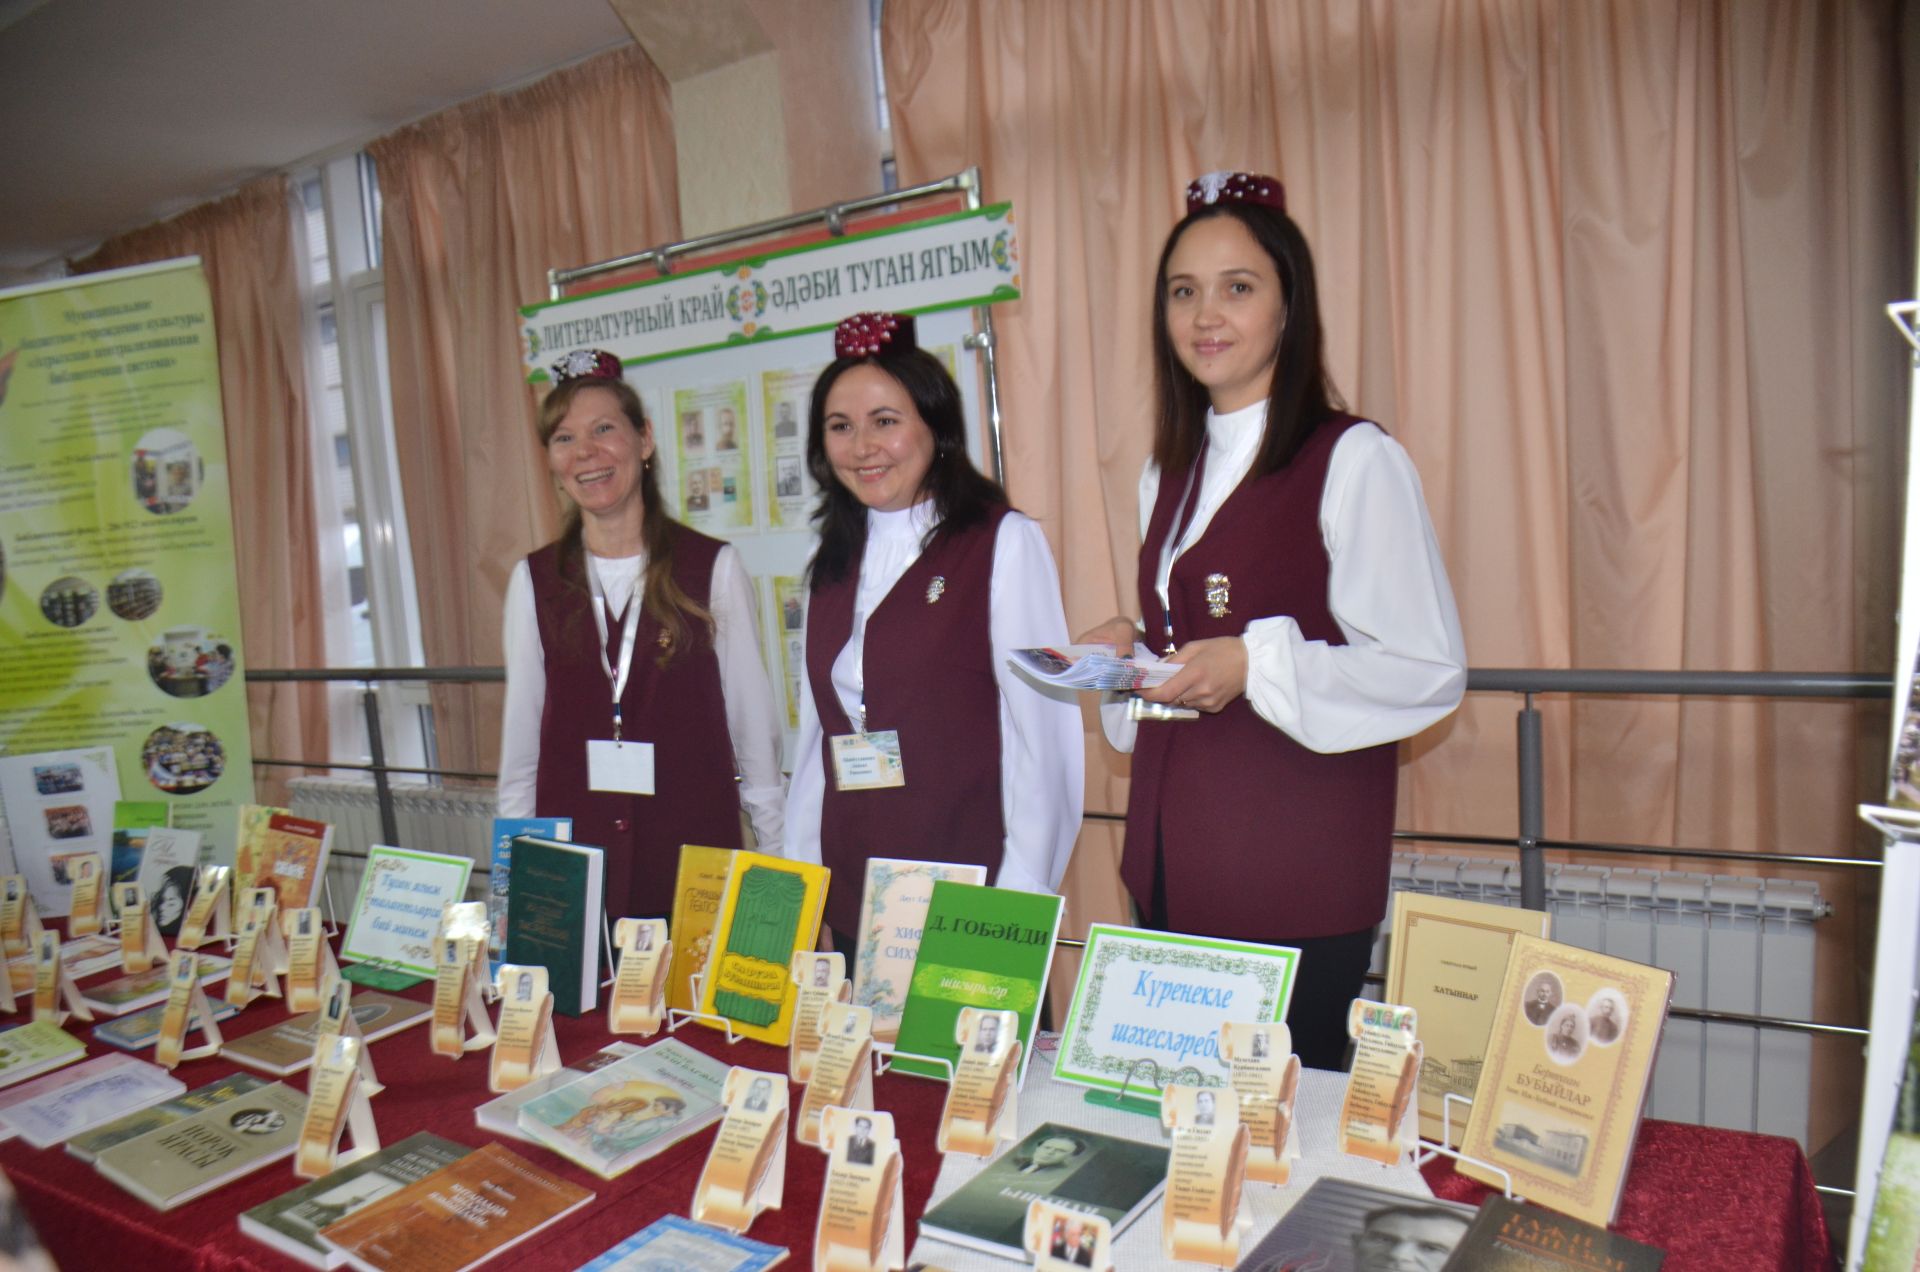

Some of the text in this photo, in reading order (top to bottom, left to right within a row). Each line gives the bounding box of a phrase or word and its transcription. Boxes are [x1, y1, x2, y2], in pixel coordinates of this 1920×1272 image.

[771, 237, 991, 312] ӘДӘБИ ТУГАН ЯГЫМ
[542, 285, 726, 350] ЛИТЕРАТУРНЫЙ КРАЙ
[929, 914, 1049, 946] Д. ГОБӘЙДИ
[1132, 969, 1234, 1009] Күренекле
[1433, 985, 1479, 1001] ХАТЫННАР
[1516, 1072, 1592, 1107] БУБЫЙЛАР
